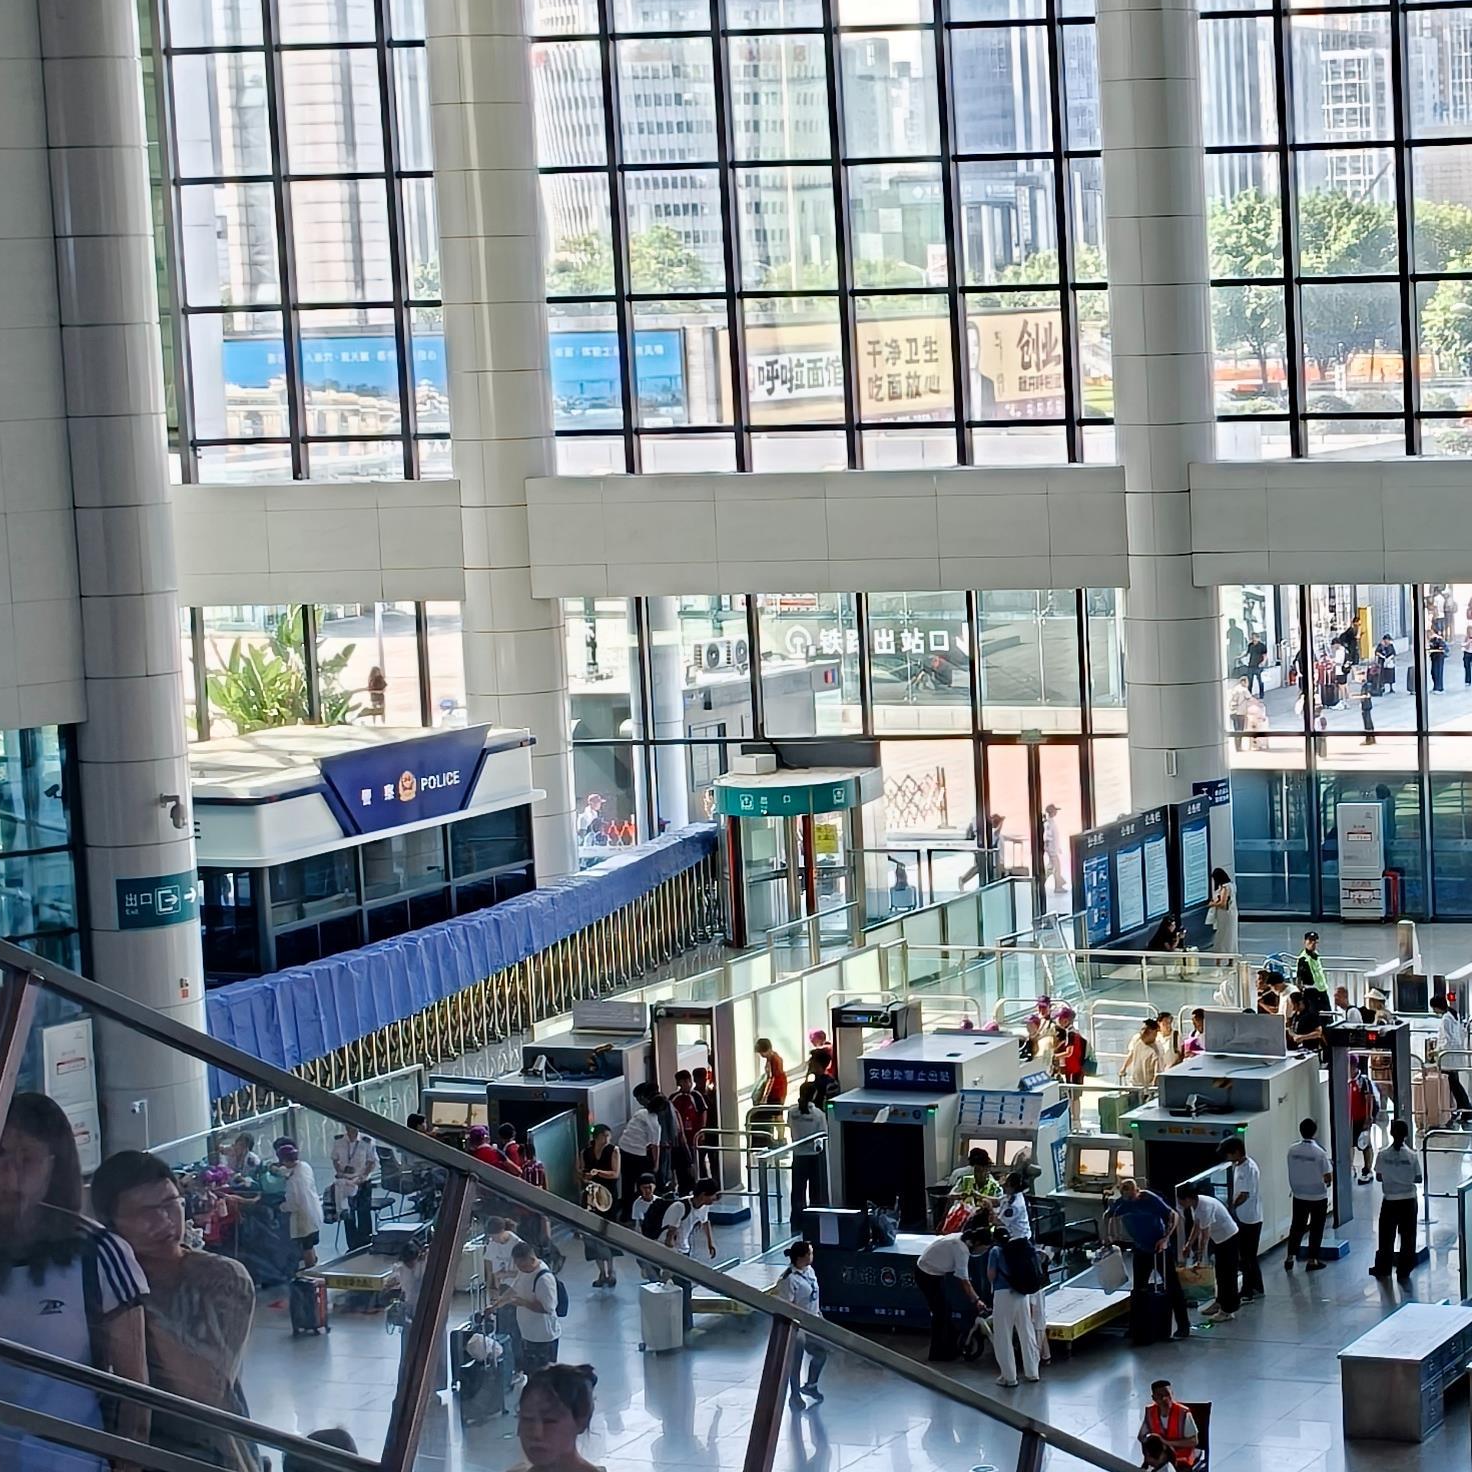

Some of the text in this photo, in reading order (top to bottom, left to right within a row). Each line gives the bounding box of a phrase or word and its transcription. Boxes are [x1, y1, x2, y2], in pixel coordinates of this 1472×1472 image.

[866, 336, 939, 368] 干净卫生
[1016, 319, 1061, 372] 创业
[868, 371, 941, 402] 吃面放心
[420, 770, 460, 791] POLICE
[125, 893, 153, 907] 出口
